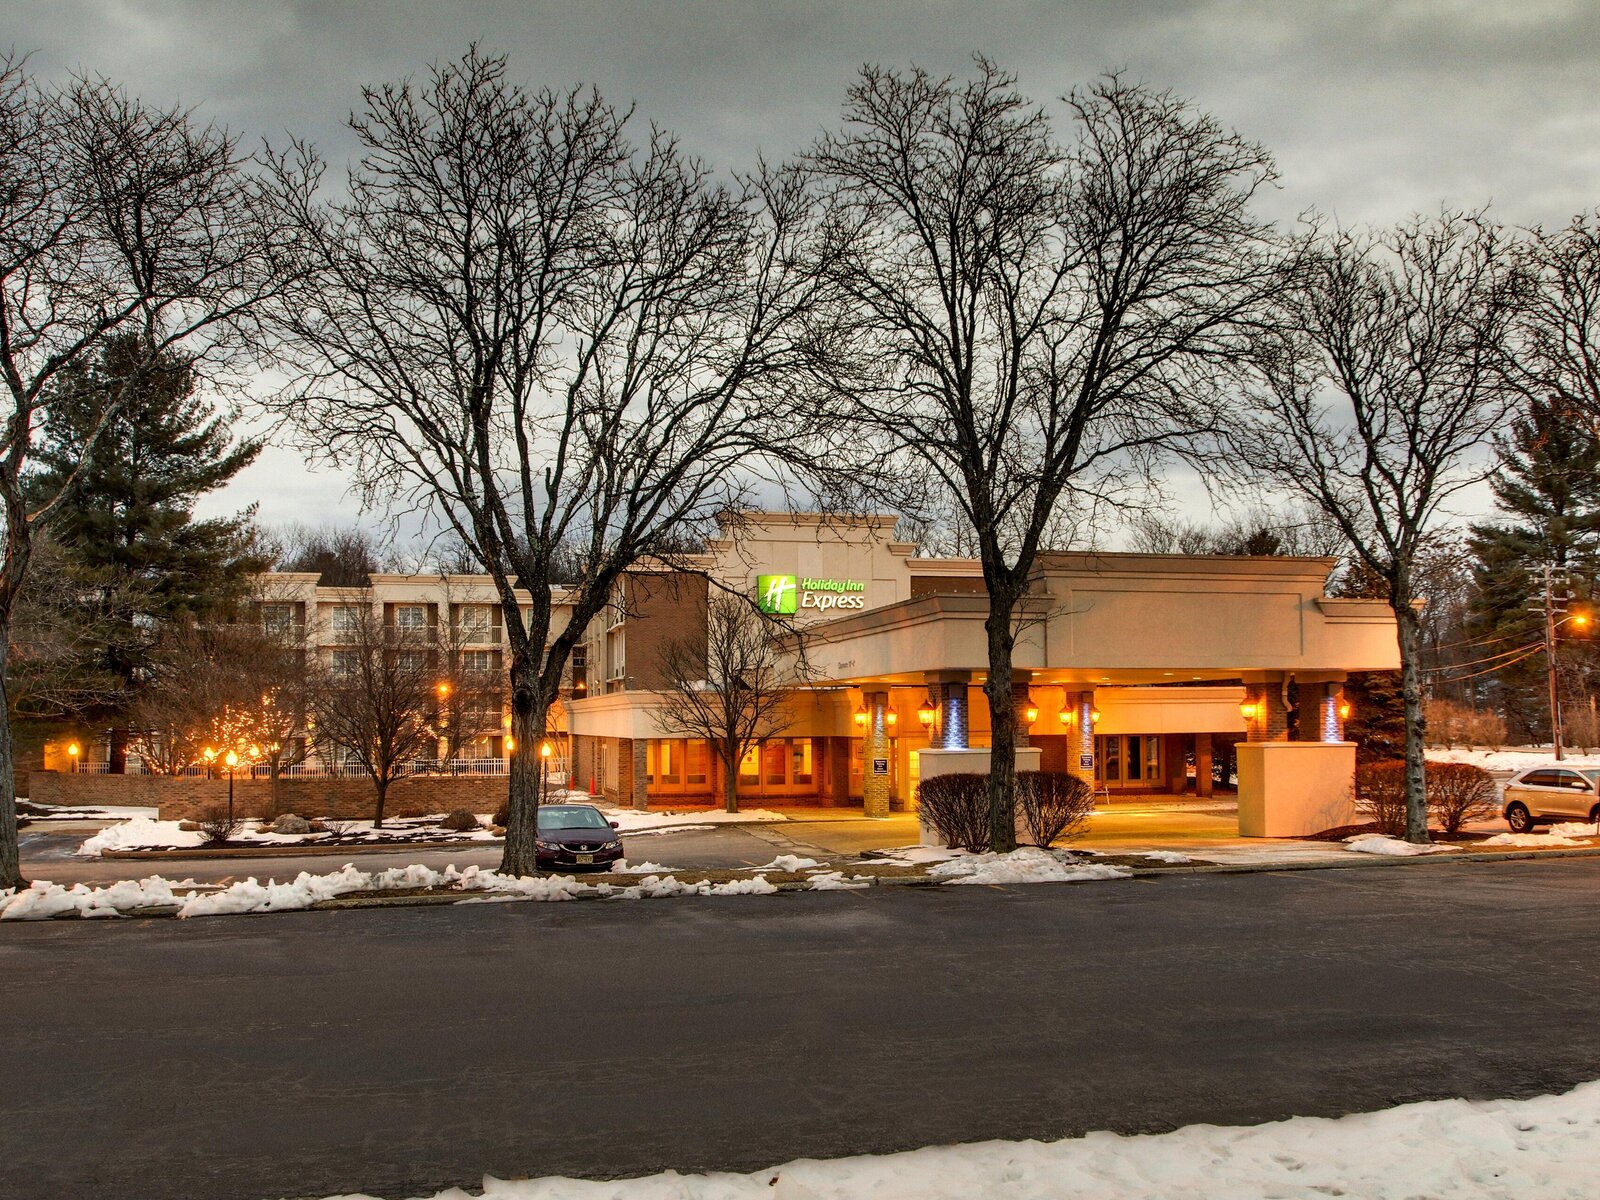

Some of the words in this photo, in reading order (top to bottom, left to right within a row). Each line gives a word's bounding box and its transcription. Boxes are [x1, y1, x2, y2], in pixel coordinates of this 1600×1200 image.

[801, 577, 846, 594] Holiday
[846, 579, 864, 591] Inn
[801, 591, 864, 612] Express
